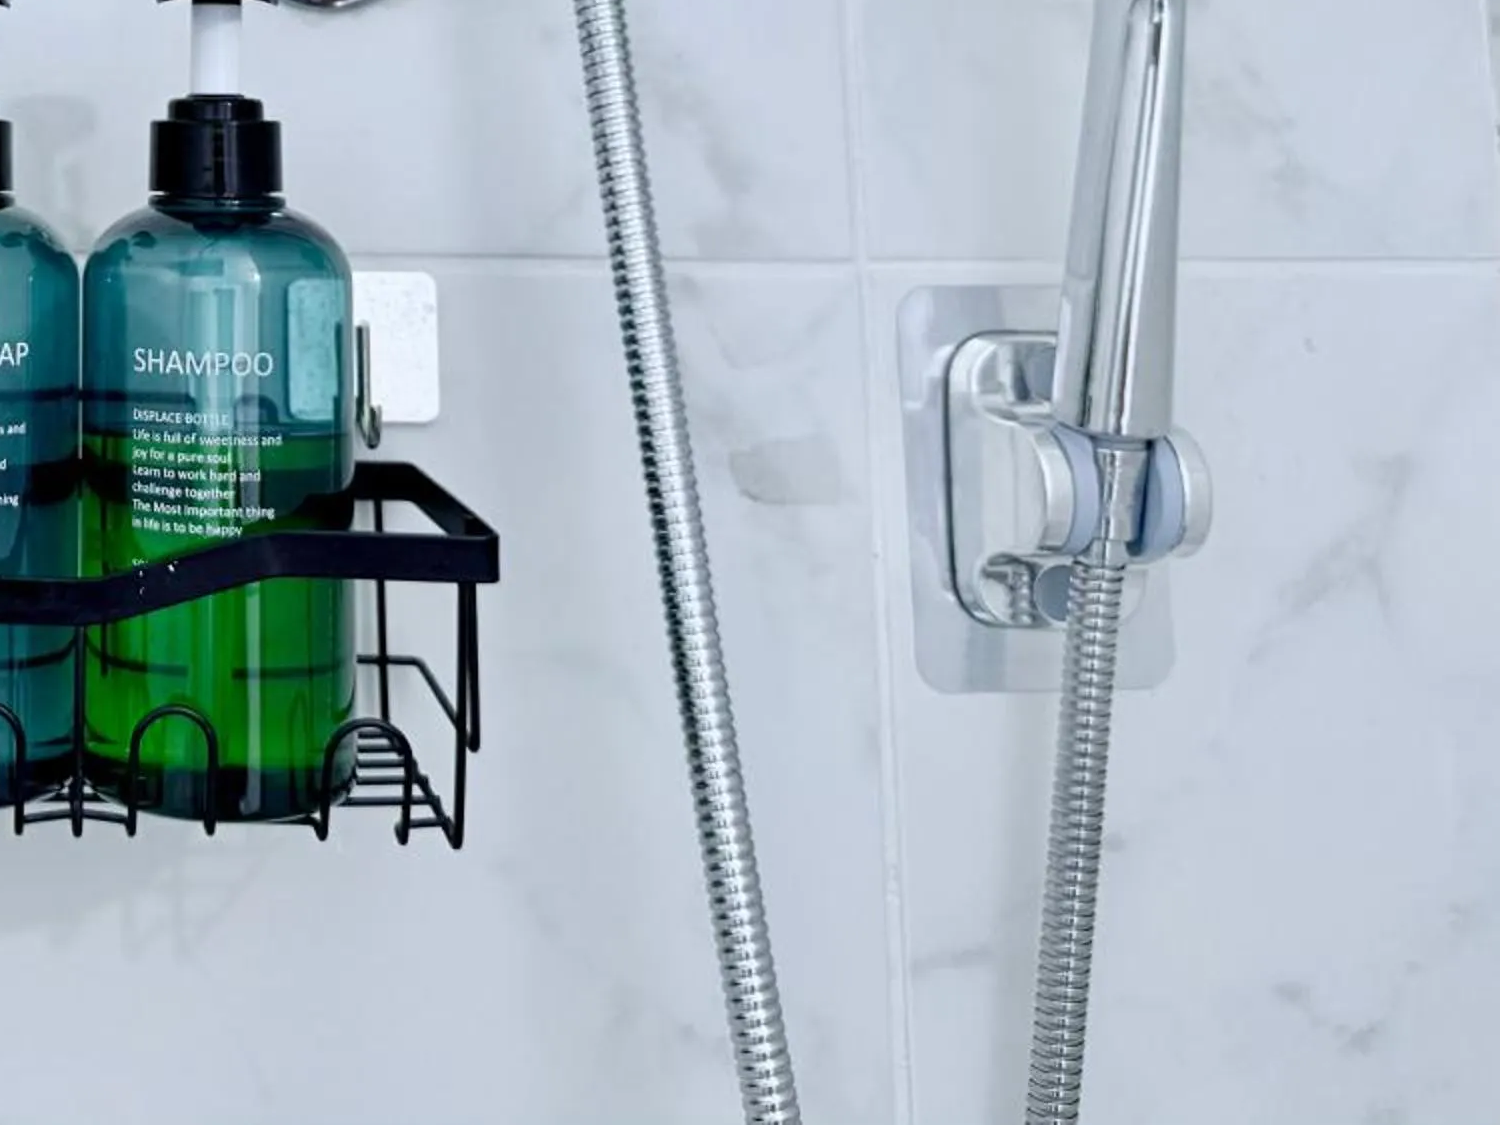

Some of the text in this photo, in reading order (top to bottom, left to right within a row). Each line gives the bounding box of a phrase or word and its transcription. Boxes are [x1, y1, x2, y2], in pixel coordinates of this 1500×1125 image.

[132, 346, 275, 377] SHAMPOO
[132, 407, 230, 426] DISPLACE BOTTLE
[7, 421, 27, 435] and
[132, 428, 151, 442] Life
[163, 431, 182, 444] full
[184, 432, 198, 445] of
[199, 434, 259, 447] sweetness
[261, 434, 284, 446] and
[132, 447, 232, 465] joy for a pure soul
[132, 464, 262, 484] Learn to work hard and
[132, 480, 237, 501] challenge together
[132, 498, 151, 512] The
[153, 501, 183, 516] Most
[244, 505, 276, 521] thing
[143, 517, 161, 531] life
[162, 518, 172, 532] is
[173, 521, 187, 534] to
[187, 521, 204, 535] be
[204, 523, 244, 539] happy
